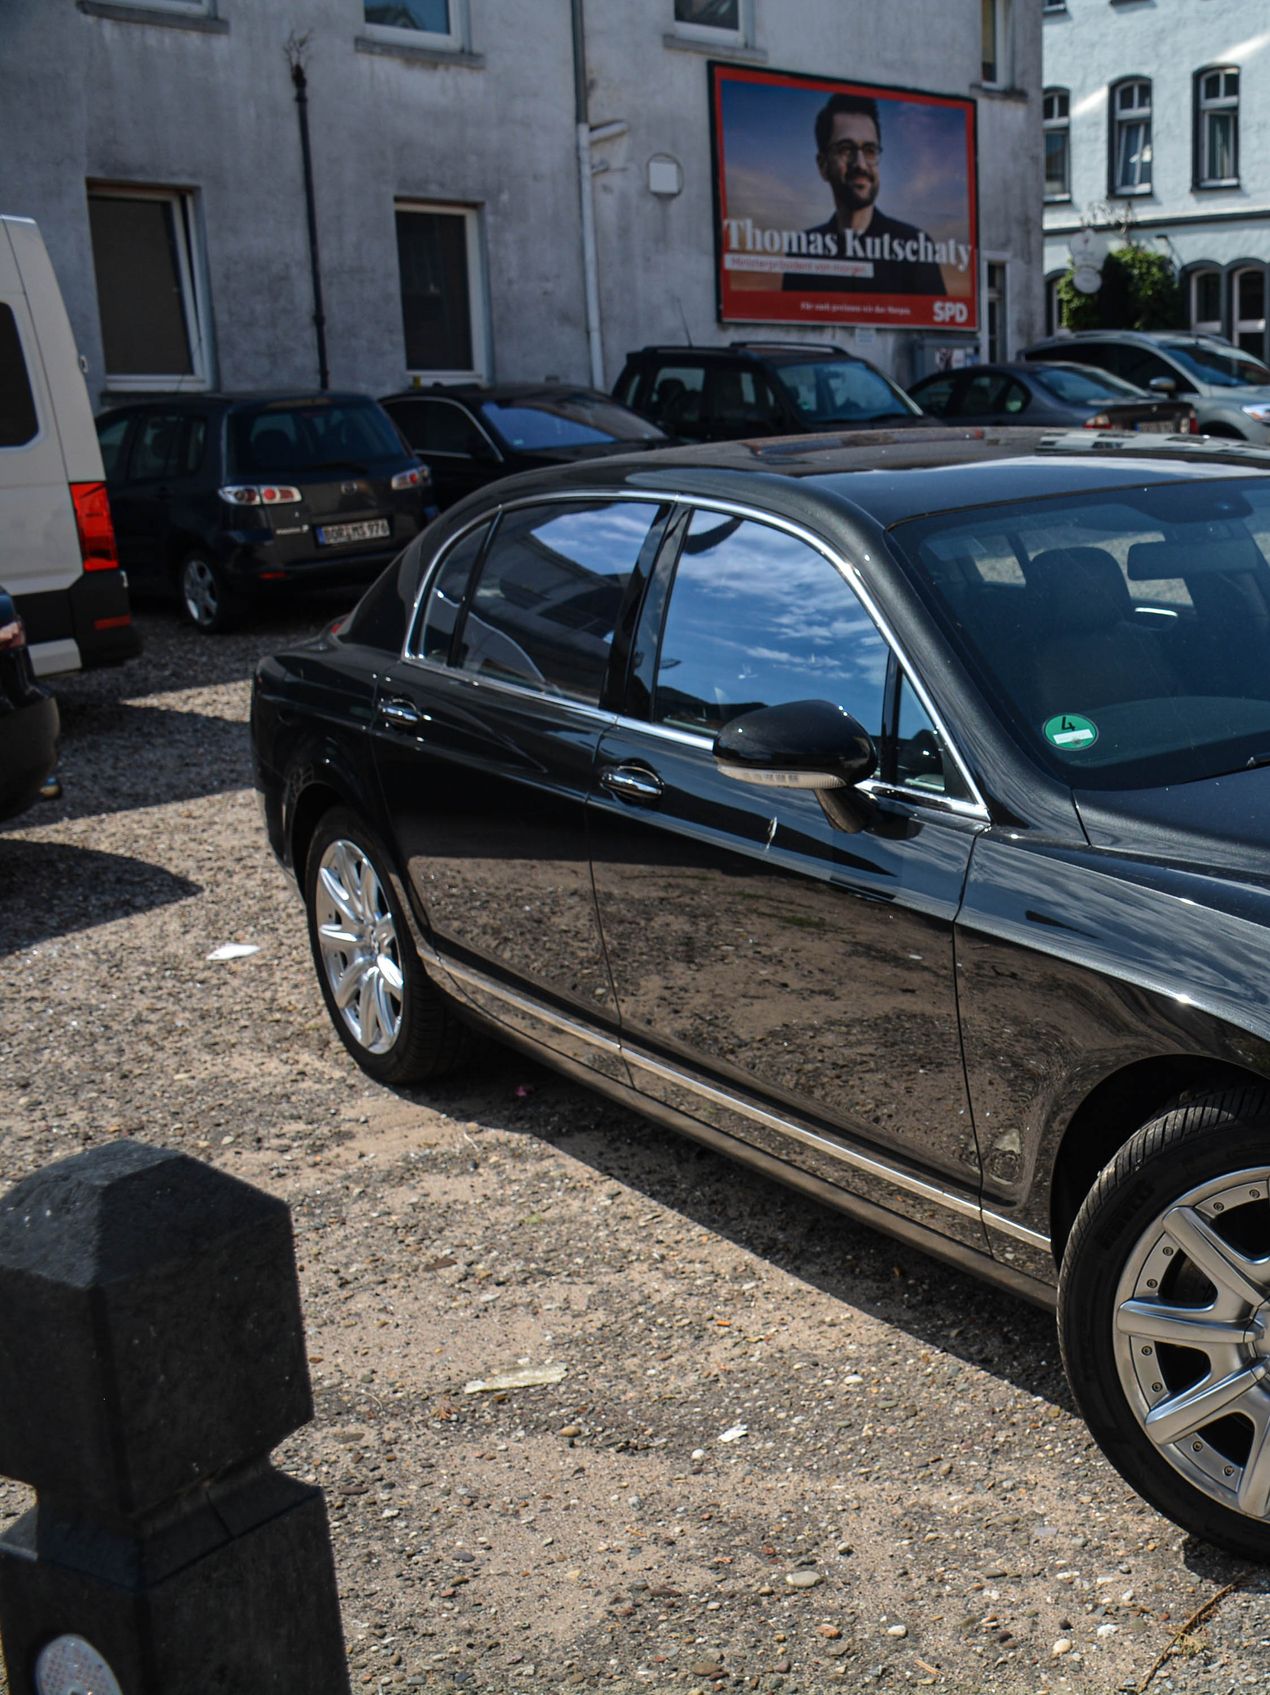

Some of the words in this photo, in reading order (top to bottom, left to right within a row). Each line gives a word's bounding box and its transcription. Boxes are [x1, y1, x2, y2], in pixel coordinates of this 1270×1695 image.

[723, 218, 838, 257] Thomas
[844, 228, 973, 272] Kutschaty
[933, 301, 968, 323] SPD
[1061, 716, 1075, 731] 4
